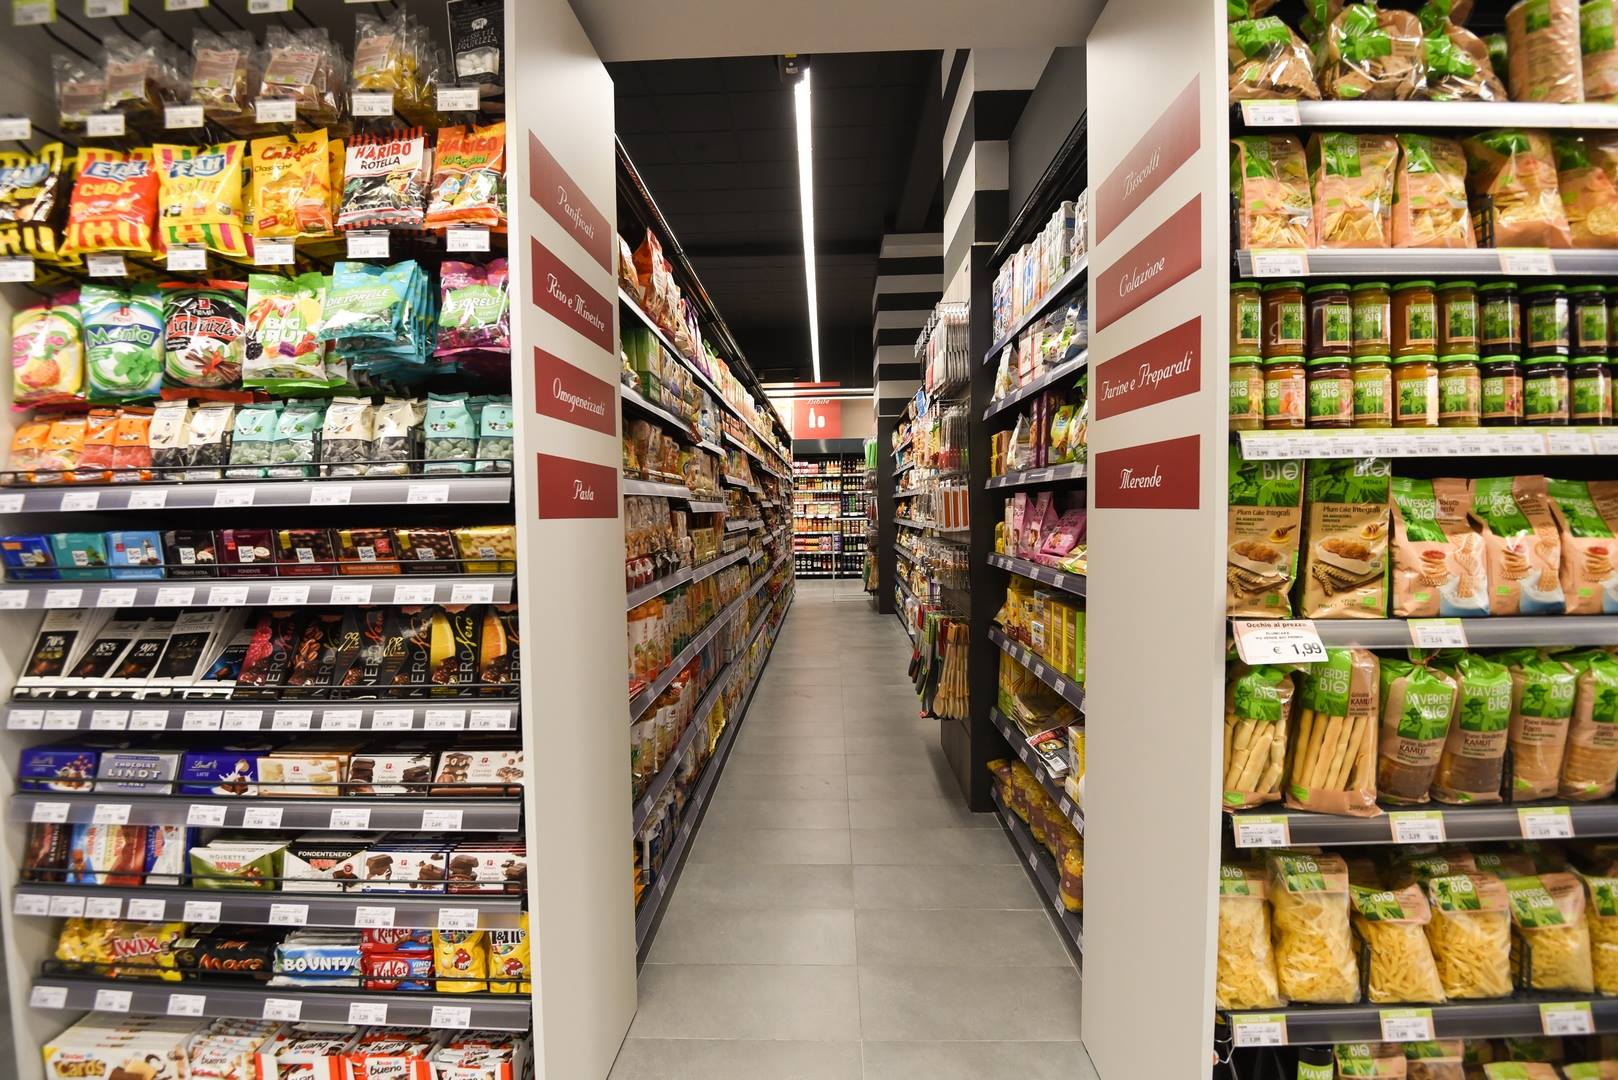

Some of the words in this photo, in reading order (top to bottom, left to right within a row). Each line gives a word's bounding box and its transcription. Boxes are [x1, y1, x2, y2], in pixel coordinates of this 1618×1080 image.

[355, 142, 411, 161] HARIBO
[440, 137, 498, 153] HARIBO
[360, 156, 401, 170] ROTELLA
[1122, 147, 1161, 200] Biscotti
[557, 185, 595, 240] Panificati
[1119, 256, 1166, 297] Colazione
[547, 273, 567, 304] Riso
[574, 294, 605, 331] Minestre
[1101, 380, 1129, 401] Farine
[1130, 378, 1136, 391] e
[1138, 351, 1193, 390] Preparati
[552, 377, 606, 416] Omogeneizzati
[1321, 389, 1339, 398] BIO
[1366, 387, 1383, 396] BIO
[1447, 386, 1466, 395] BIO
[1485, 387, 1503, 396] BIO
[1262, 461, 1299, 481] BIO
[1353, 459, 1390, 477] BIO
[1119, 465, 1162, 489] Merende
[573, 479, 594, 501] Pasta
[1266, 509, 1290, 518] Integrali
[1323, 505, 1338, 513] Plum
[1412, 509, 1434, 520] BIO
[1491, 504, 1518, 517] BIO
[1273, 647, 1282, 655] €
[1292, 642, 1323, 657] 1,99
[1319, 678, 1348, 694] BIO
[1551, 685, 1575, 699] BIO
[1254, 688, 1276, 699] BIO
[1350, 697, 1373, 705] KAMUT
[1487, 696, 1511, 711] BIO
[1422, 704, 1449, 720] BIO
[1464, 738, 1491, 746] KAMUT
[1400, 745, 1426, 755] KAMUT
[107, 769, 161, 778] LINDT
[1223, 866, 1243, 879] BIO
[1296, 861, 1318, 873] BIO
[1450, 880, 1473, 893] BIO
[1528, 894, 1553, 908] BIO
[283, 957, 352, 972] BOUNTY
[1350, 1044, 1370, 1057] BIO
[54, 1060, 105, 1077] Cards
[369, 1065, 402, 1076] bueno
